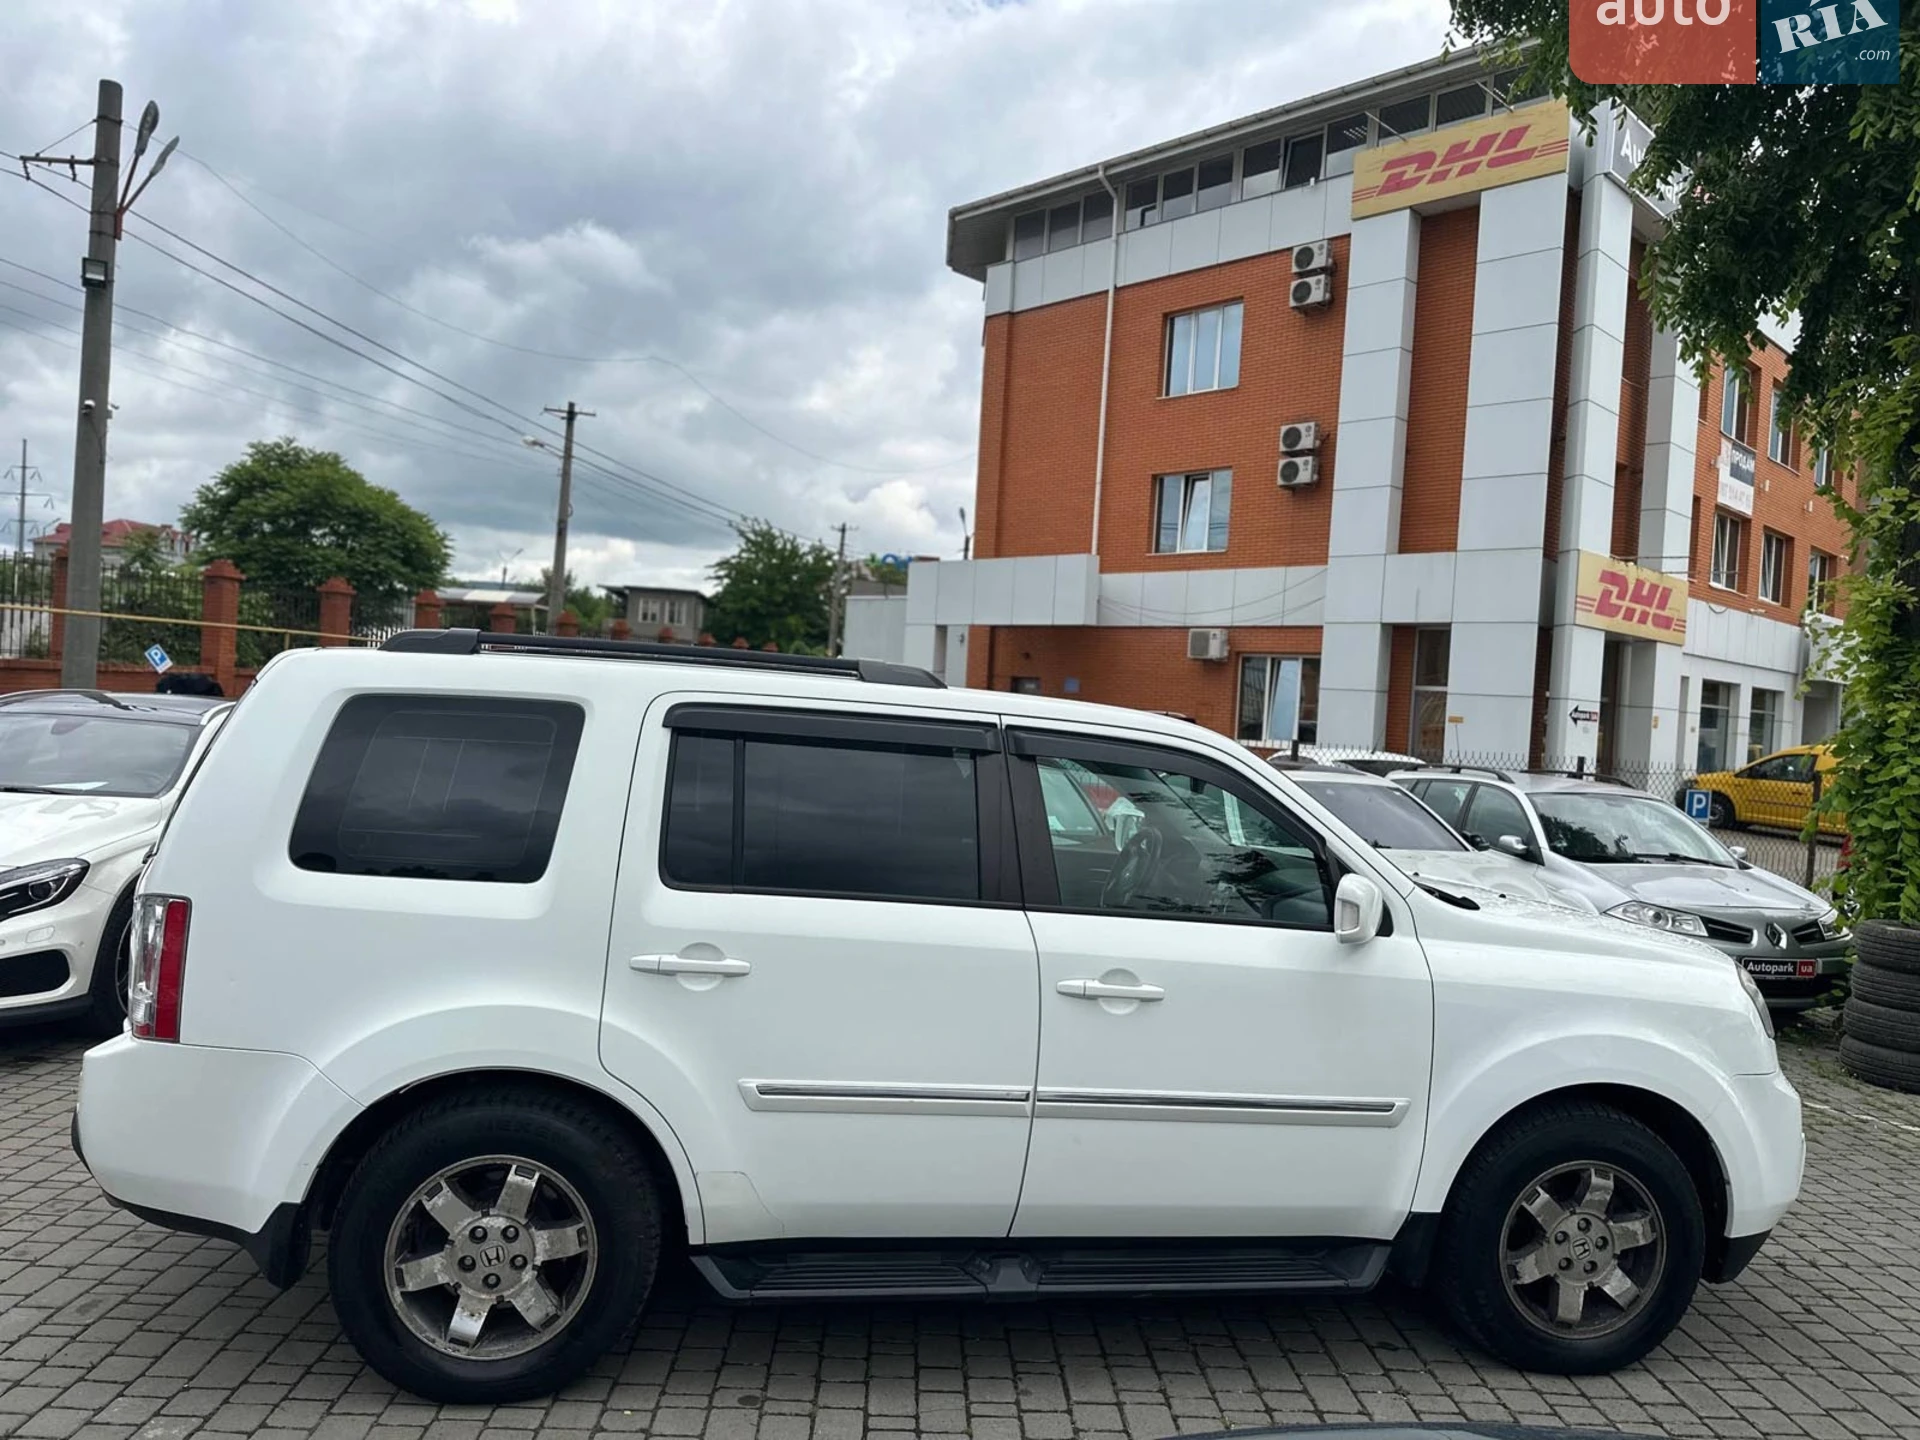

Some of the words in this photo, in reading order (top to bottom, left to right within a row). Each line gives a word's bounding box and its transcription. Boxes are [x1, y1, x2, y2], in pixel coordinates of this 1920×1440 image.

[1376, 125, 1538, 197] DHL
[1594, 569, 1675, 631] DHL
[1692, 793, 1707, 817] P
[1746, 961, 1794, 975] Autopark
[1801, 965, 1813, 973] ua
